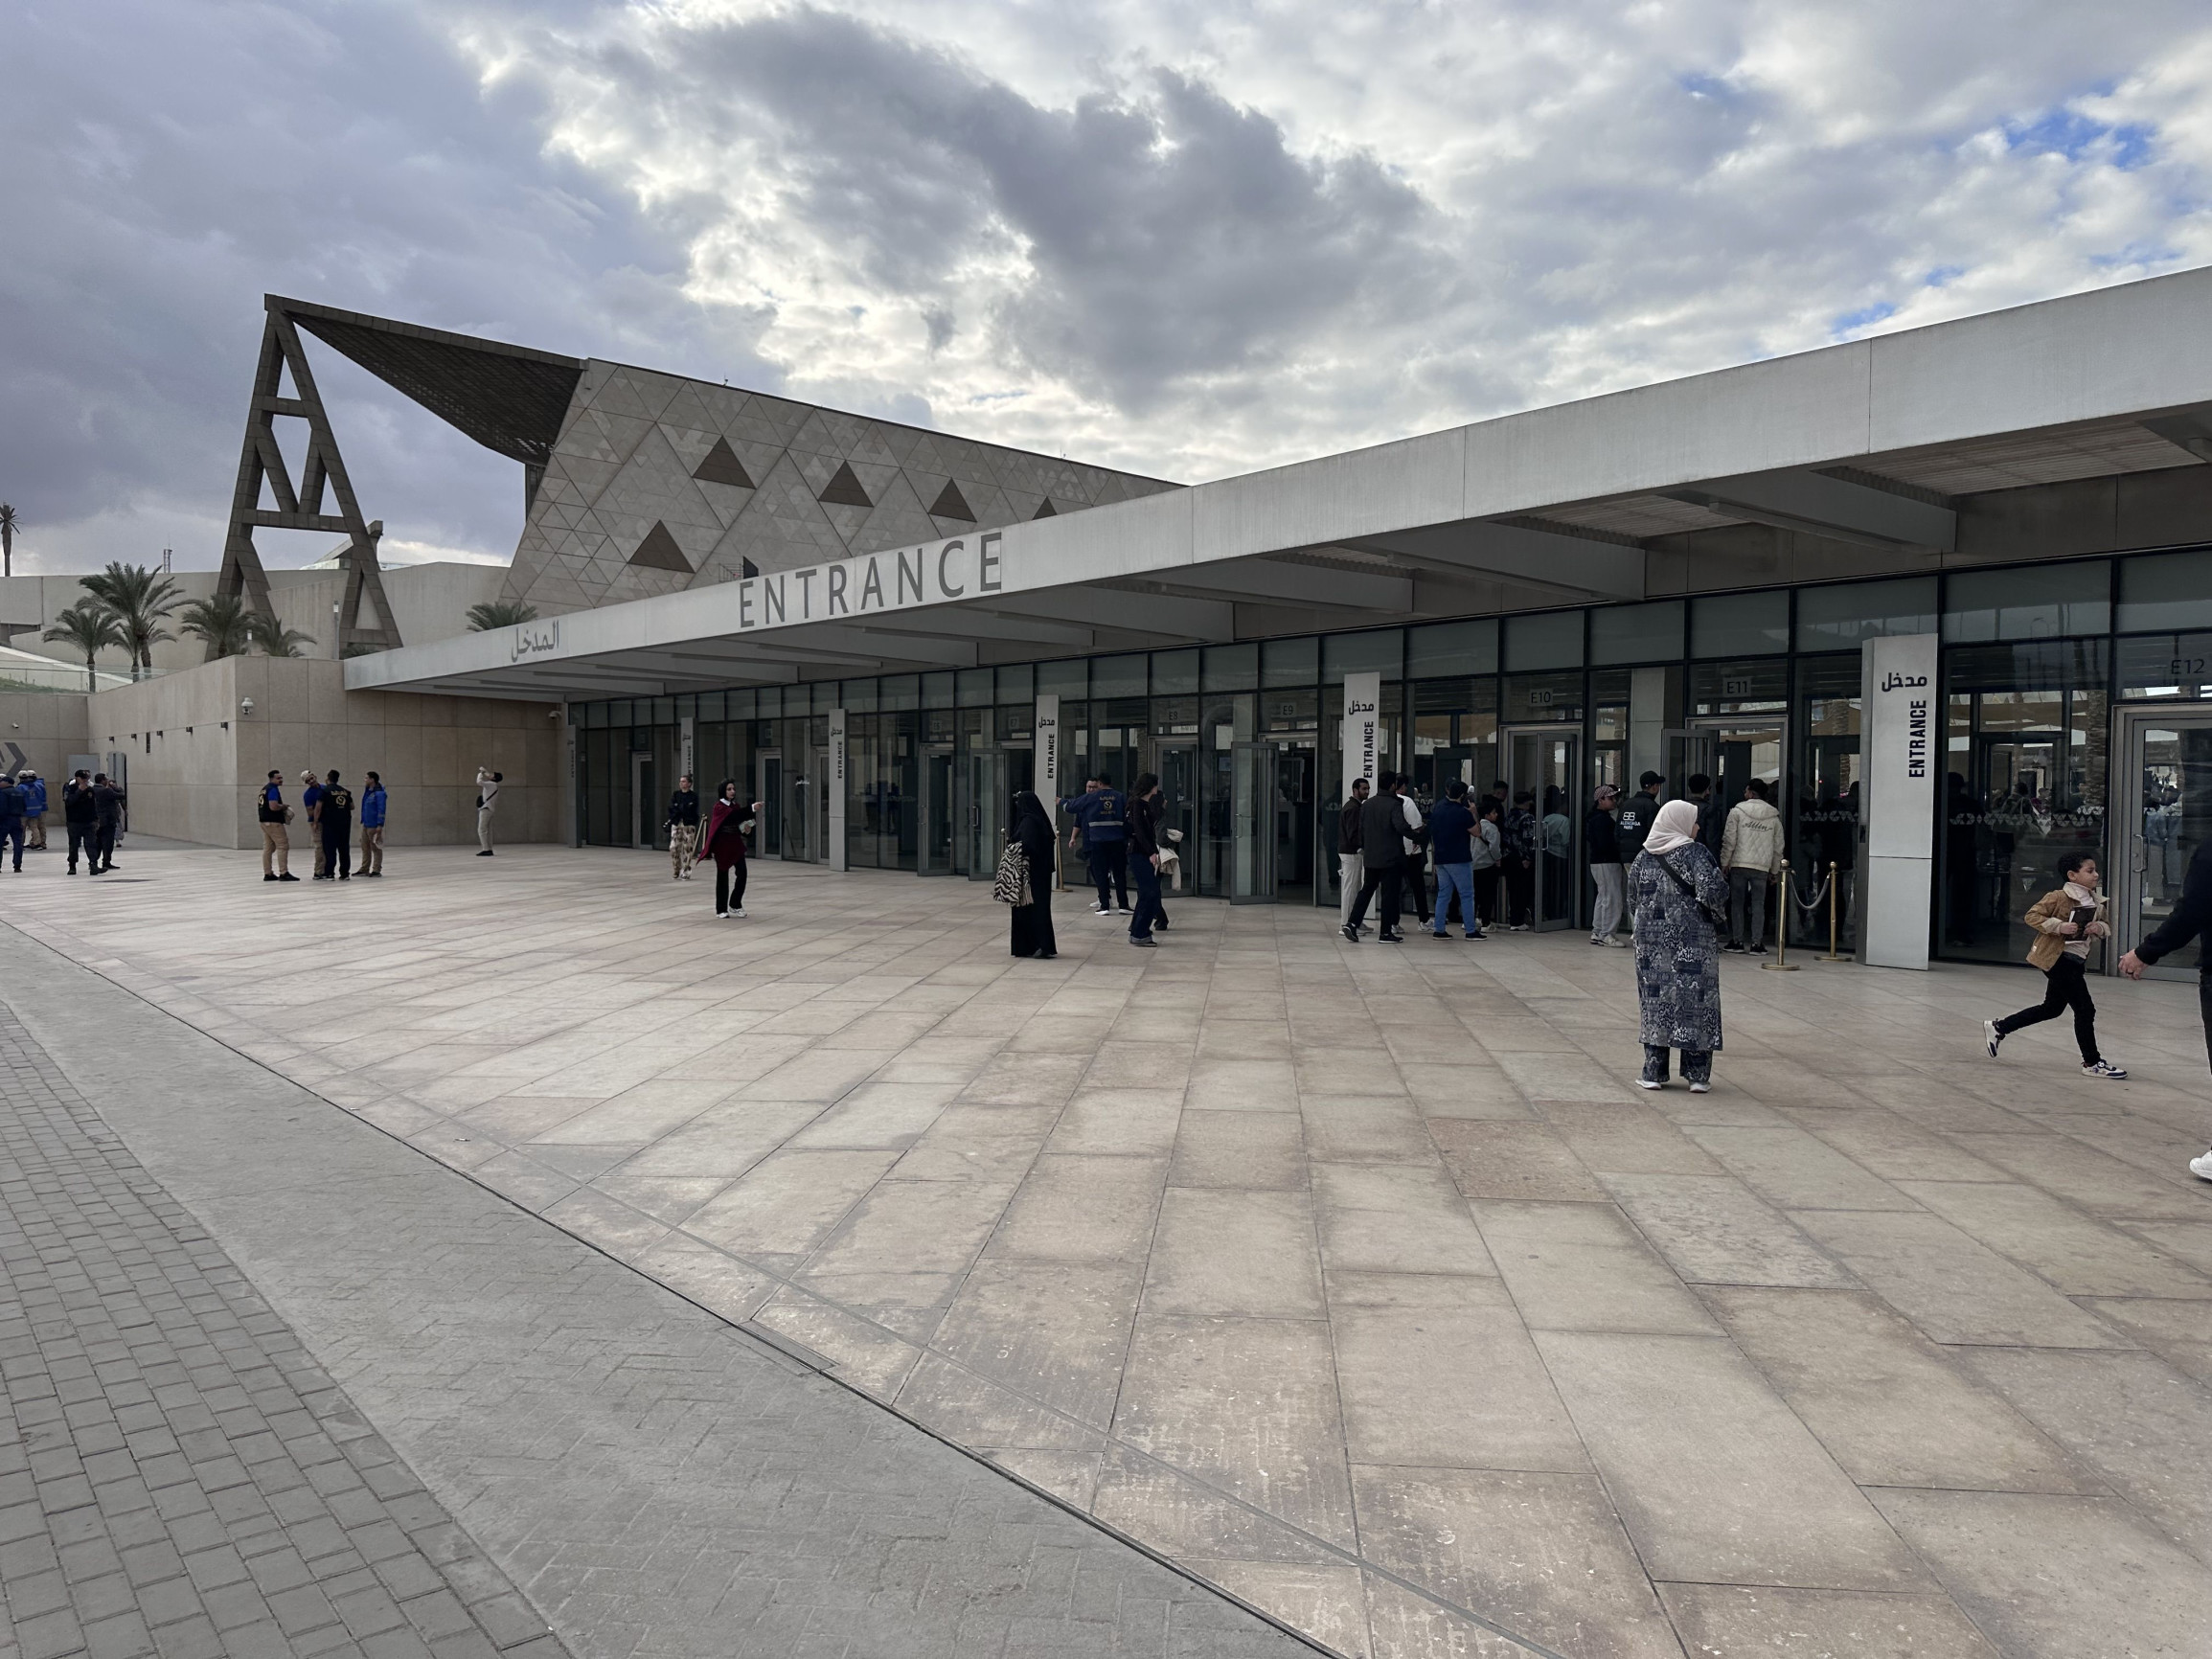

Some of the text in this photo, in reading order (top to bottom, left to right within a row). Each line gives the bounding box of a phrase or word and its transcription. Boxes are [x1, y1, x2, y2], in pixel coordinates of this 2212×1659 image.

[740, 532, 1003, 628] ENTRANCE
[511, 619, 559, 663] المدخل
[2171, 658, 2205, 674] E12
[1726, 680, 1748, 694] E11
[1881, 672, 1927, 693] مدخل
[1531, 691, 1551, 704] E10
[1169, 711, 1178, 721] E8
[1283, 704, 1293, 716] E9
[1348, 700, 1375, 716] مدخل
[1038, 716, 1055, 728] مدخل
[1908, 700, 1927, 778] ENTRANCE
[1363, 721, 1374, 779] ENTRANCE
